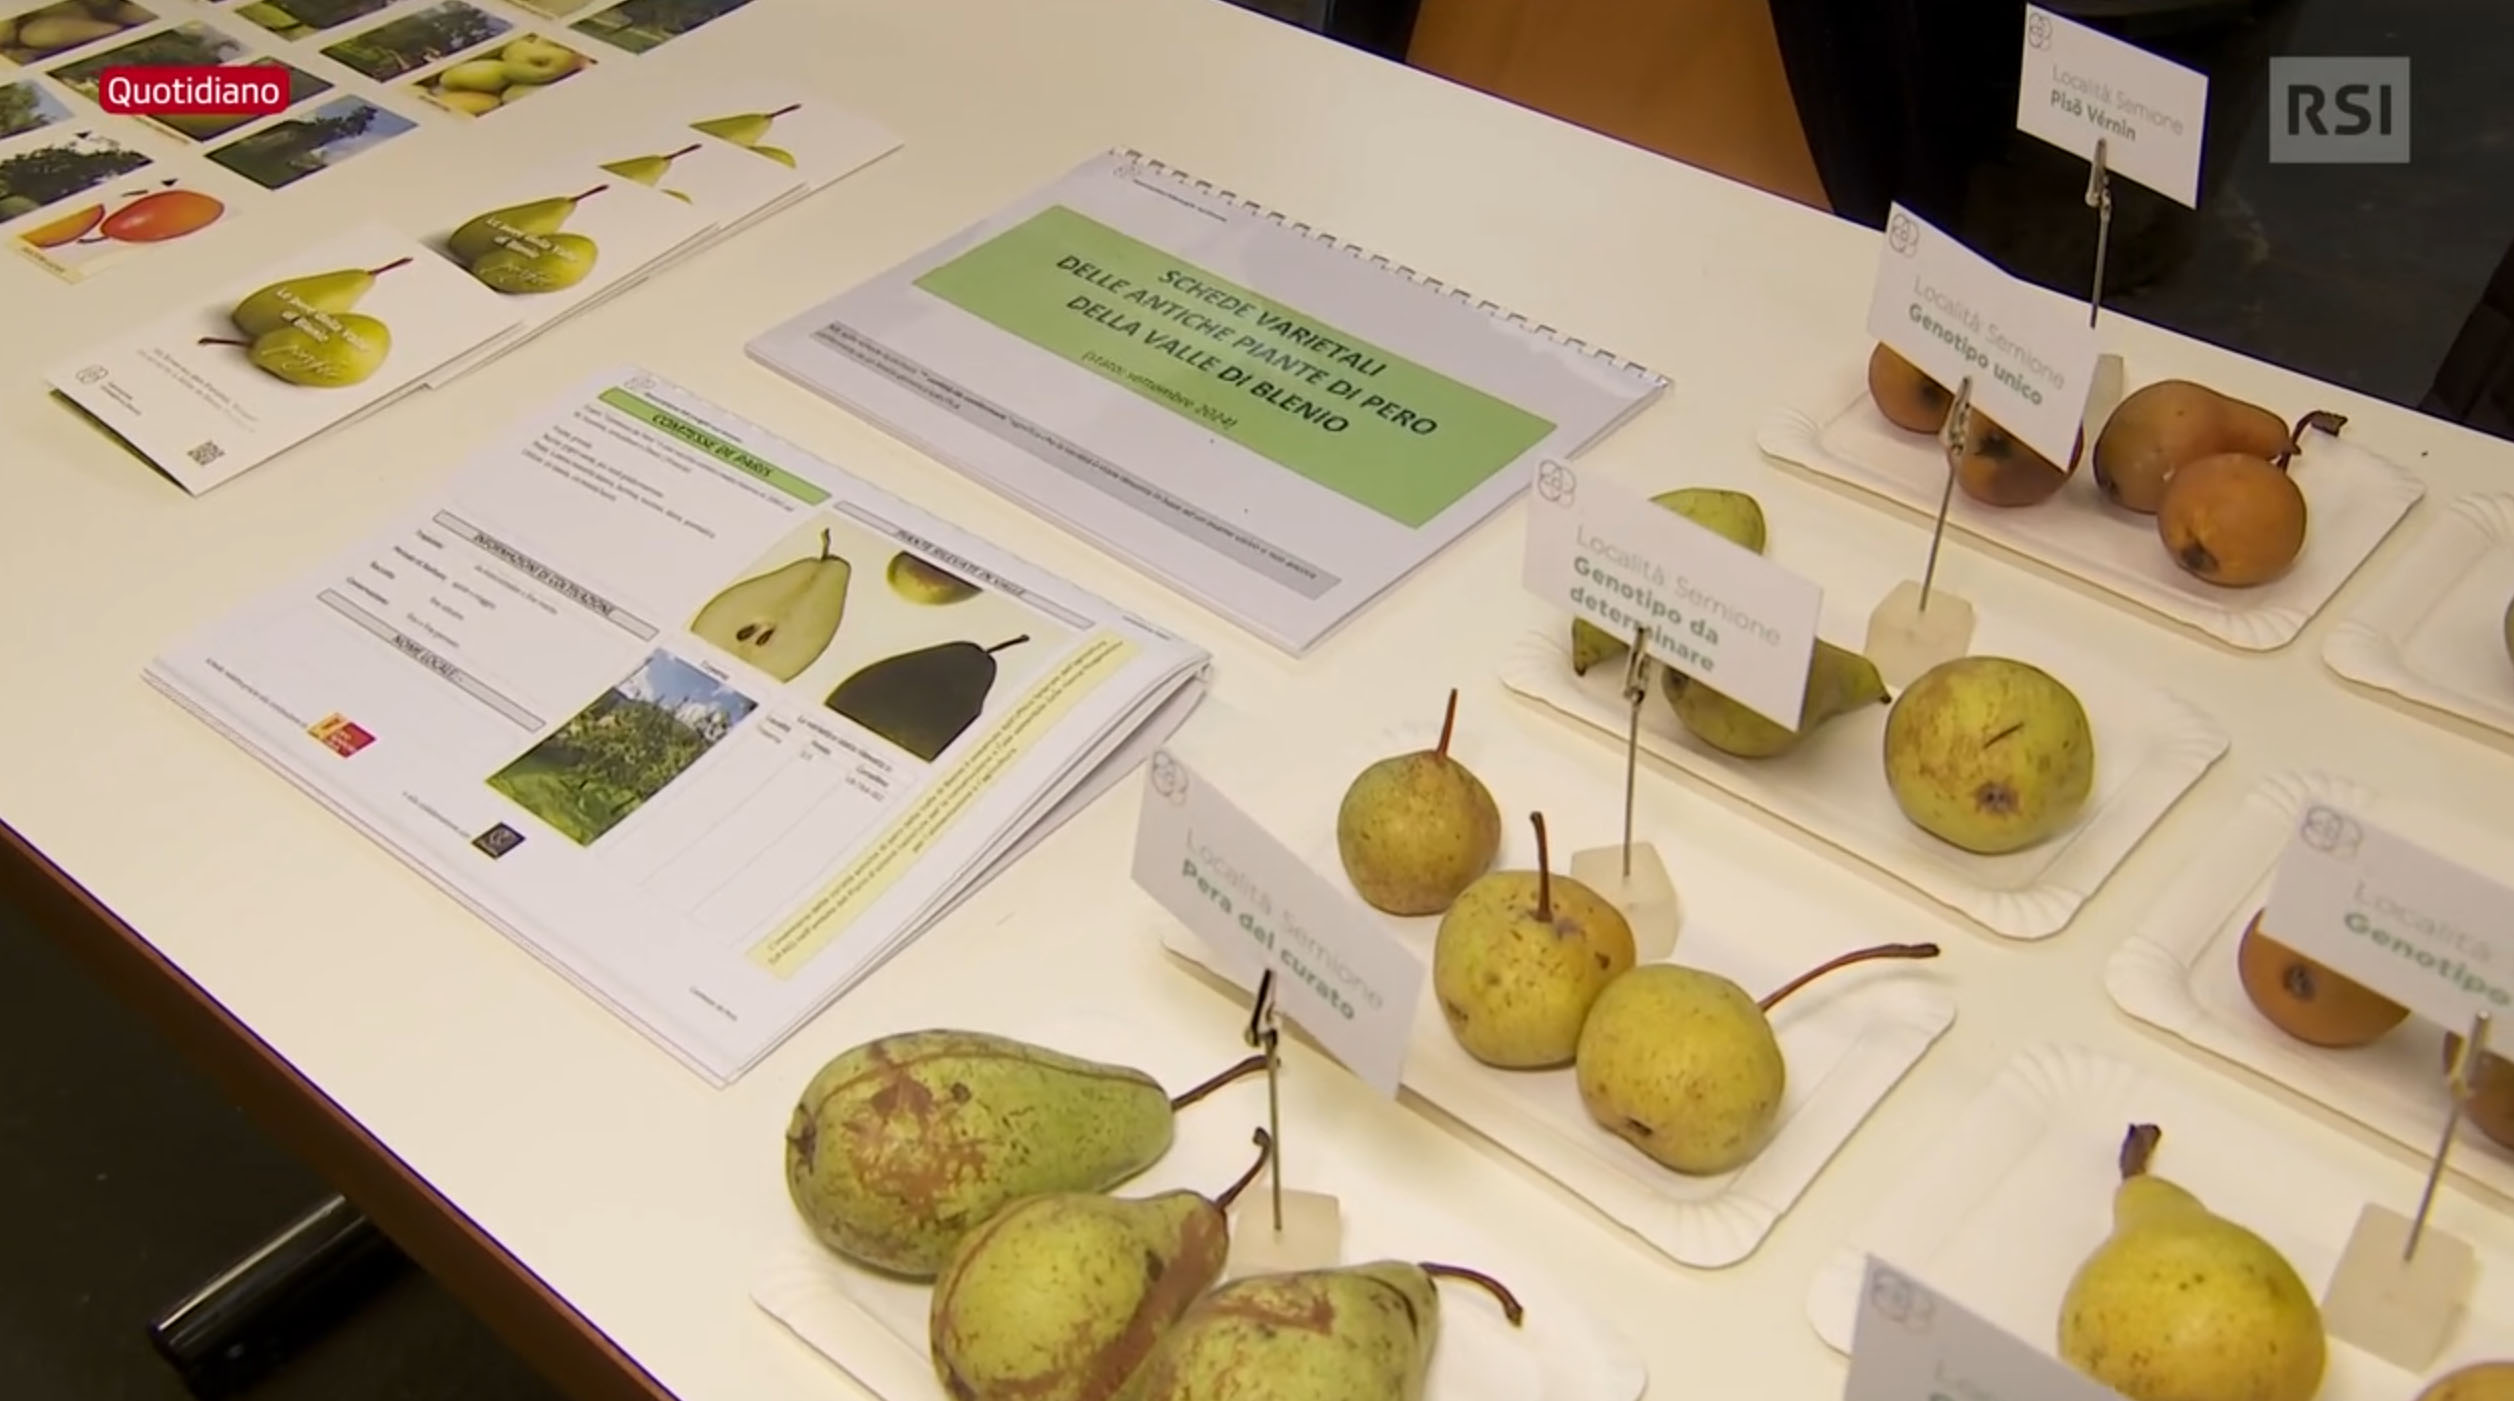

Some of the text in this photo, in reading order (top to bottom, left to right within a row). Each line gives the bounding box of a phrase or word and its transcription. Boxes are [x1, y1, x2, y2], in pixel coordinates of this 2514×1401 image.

[2116, 90, 2184, 136] Semione
[1056, 255, 1438, 435] DELLE ANTICHE PIANTE DI PERO
[1066, 295, 1349, 432] DELLA VALLE DI BLENIO
[1158, 270, 1387, 377] SCHEDE VARIETALI
[1908, 303, 2043, 406] Genotipo unico
[1913, 275, 2064, 391] Località Semione
[1570, 584, 1715, 673] determinare
[1573, 555, 1719, 645] Genotipo da
[1576, 524, 1781, 647] Località Semione
[1238, 911, 1276, 951] del
[1280, 950, 1355, 1020] curato
[1282, 909, 1384, 1011] Semione
[2344, 911, 2512, 1007] Genotipo
